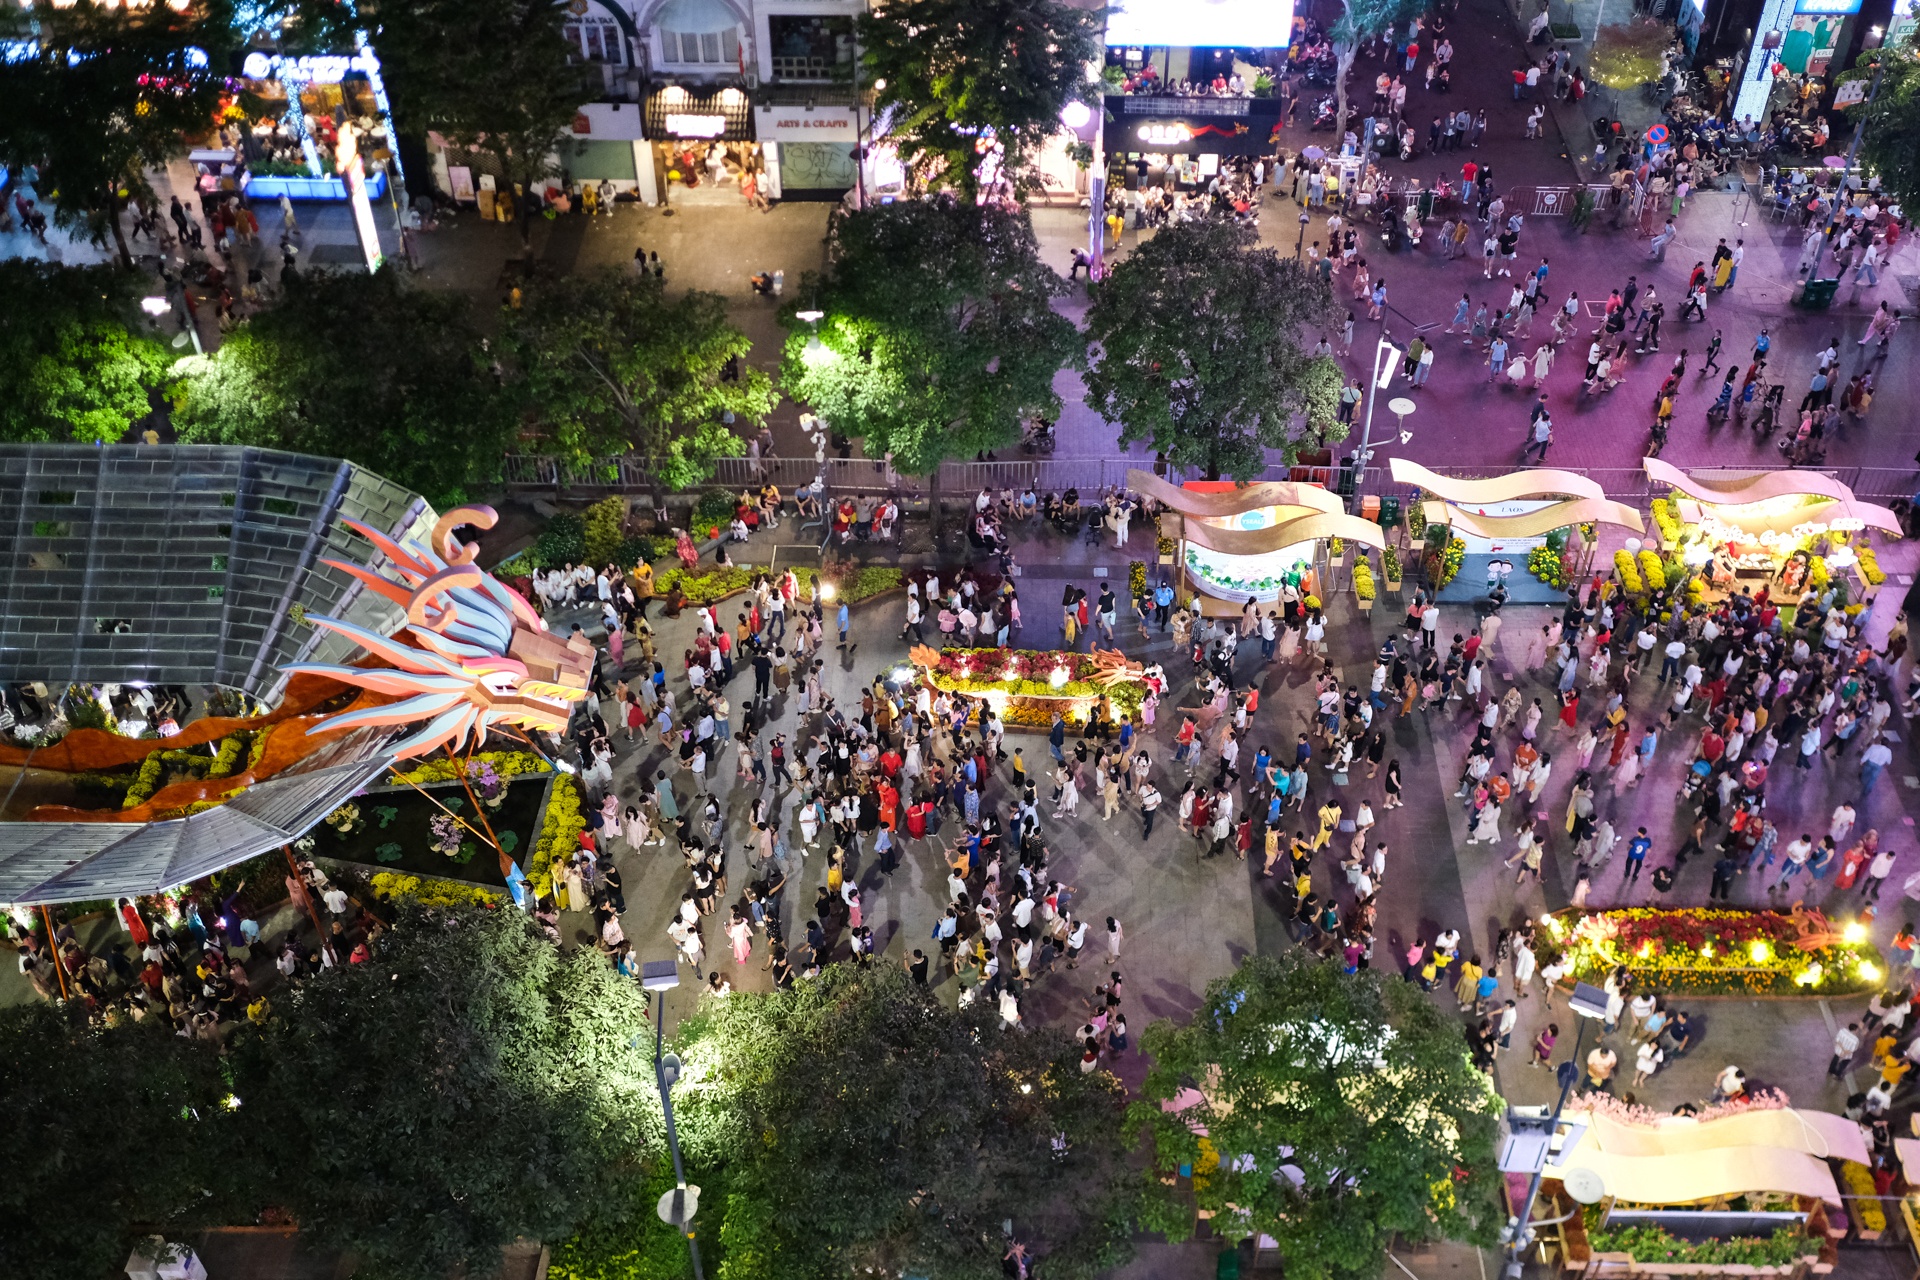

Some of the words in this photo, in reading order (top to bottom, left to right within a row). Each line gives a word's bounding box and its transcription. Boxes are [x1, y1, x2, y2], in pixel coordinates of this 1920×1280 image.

[776, 120, 800, 128] ARTS
[803, 120, 811, 128] &
[812, 120, 848, 128] CRAFTS
[1635, 845, 1643, 854] 9
